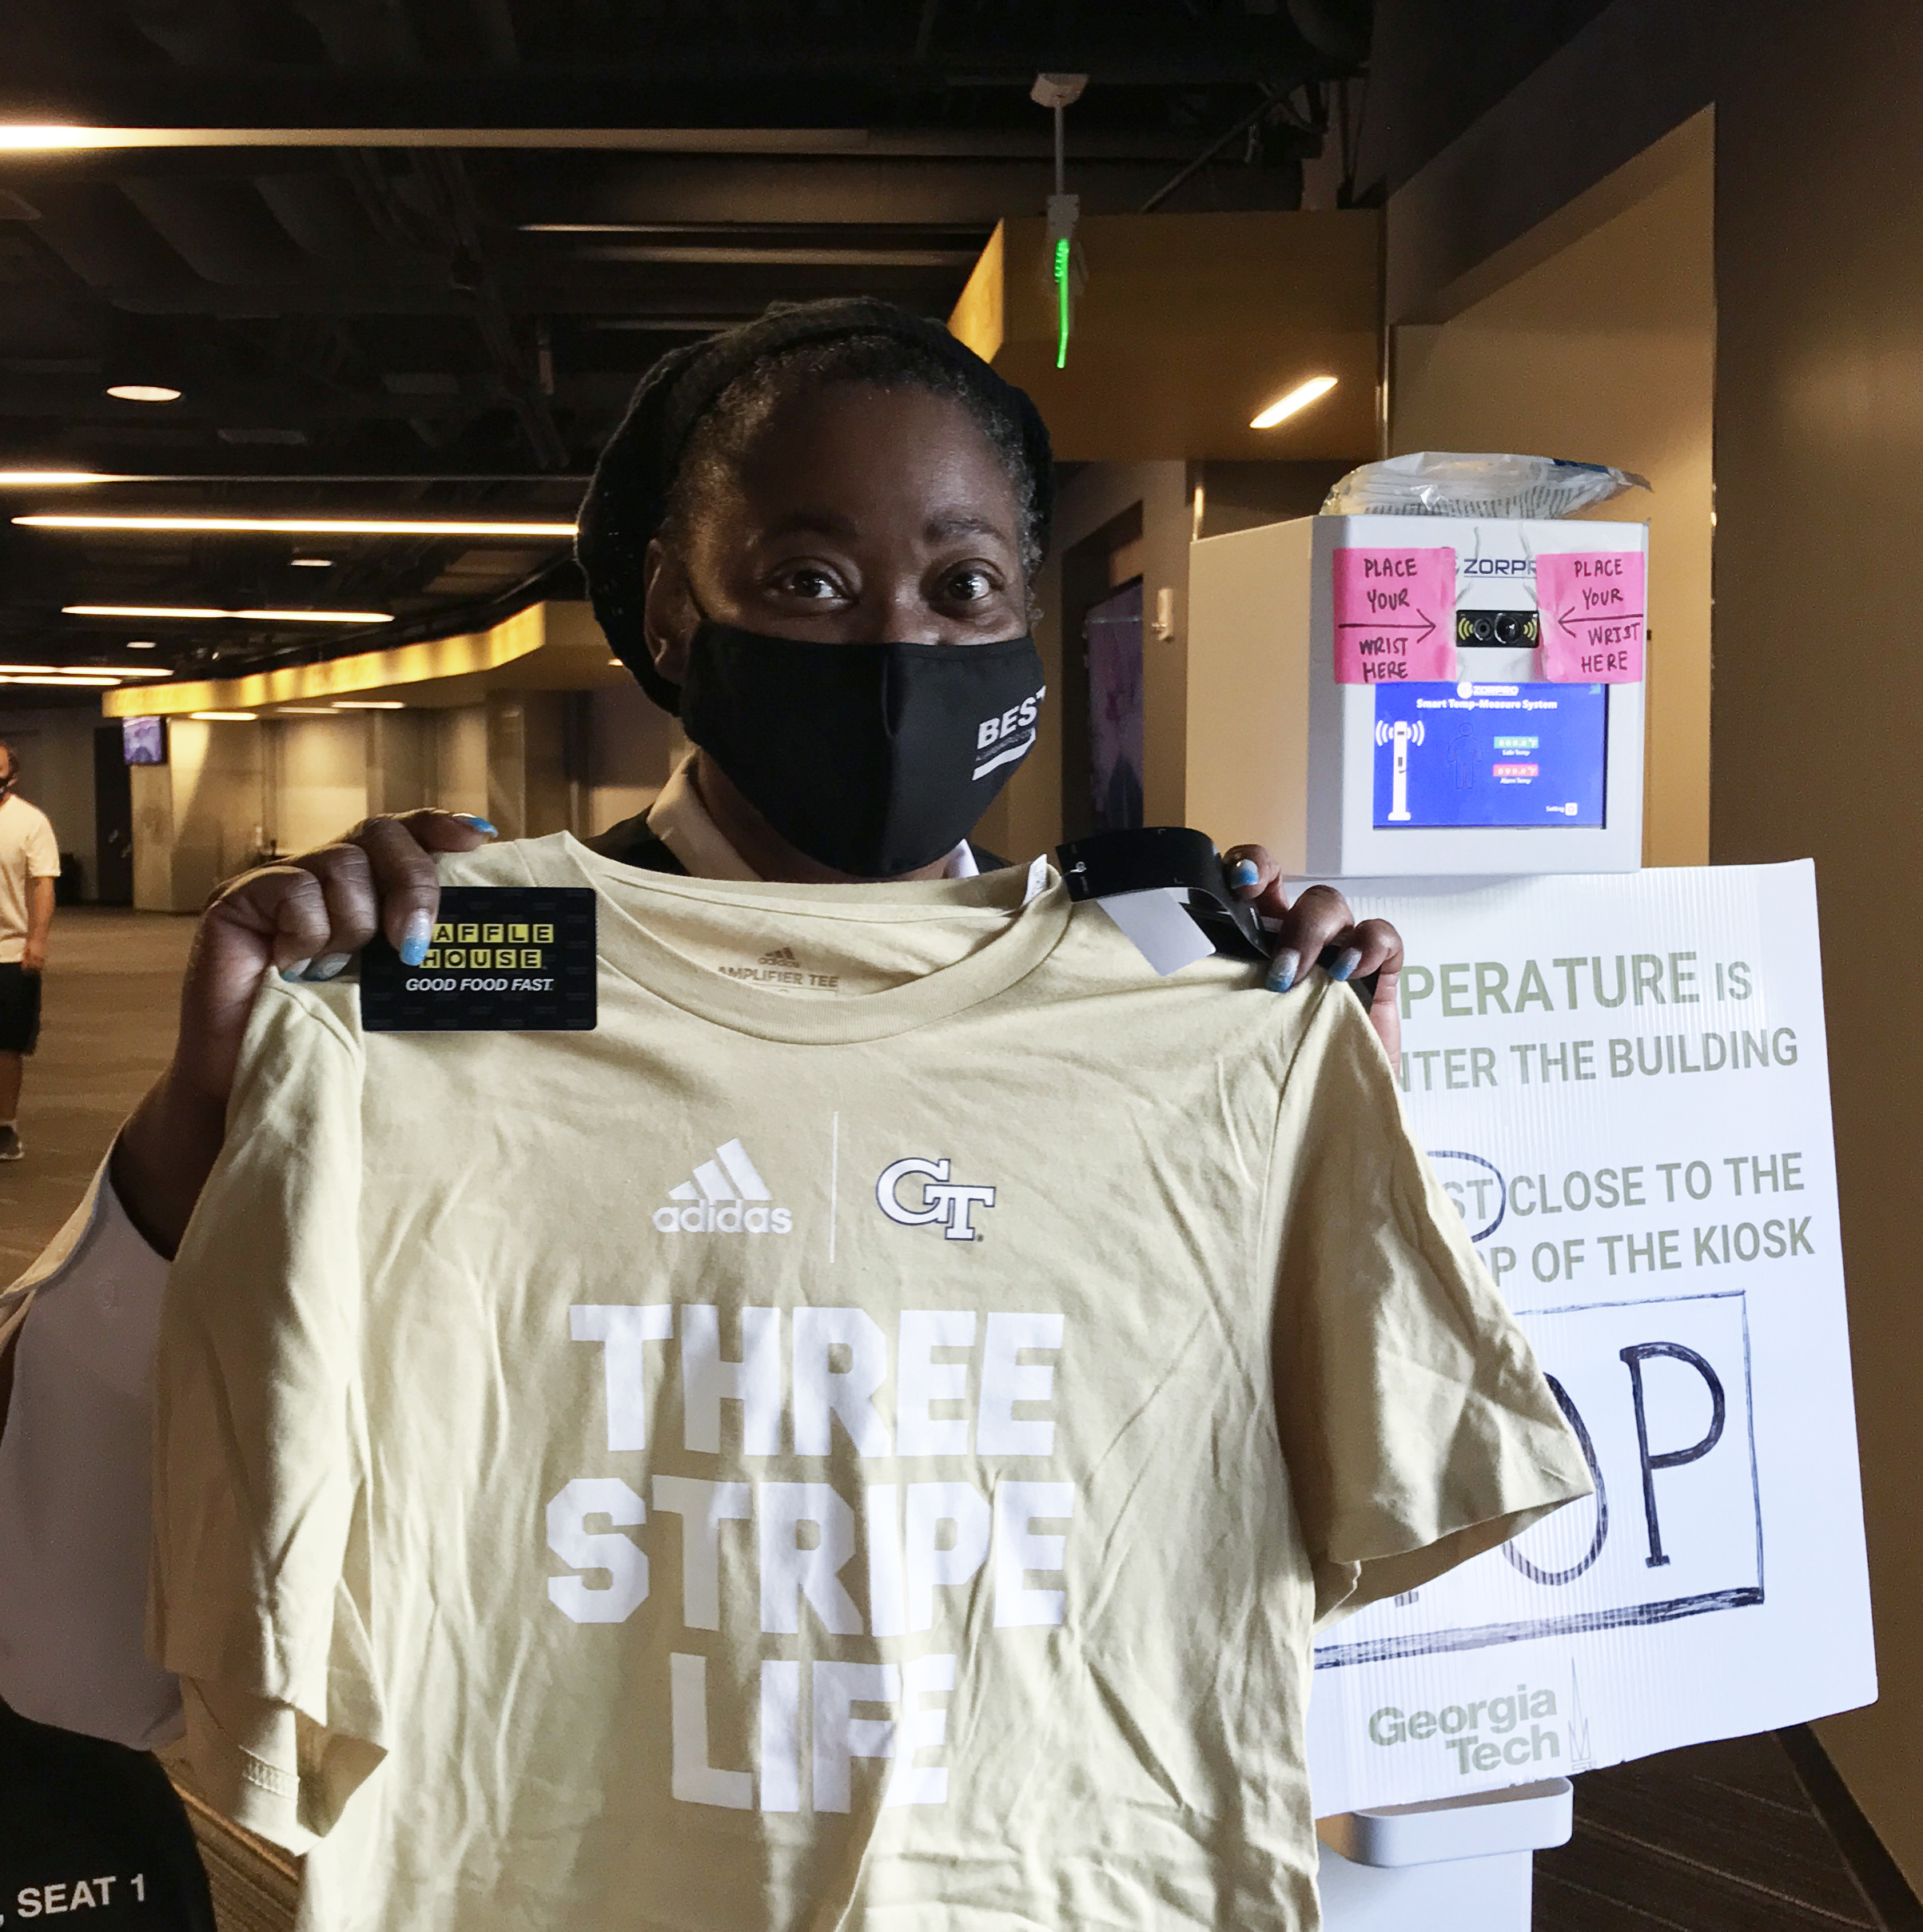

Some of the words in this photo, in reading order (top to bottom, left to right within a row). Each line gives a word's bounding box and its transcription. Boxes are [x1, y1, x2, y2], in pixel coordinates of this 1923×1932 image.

[1364, 557, 1418, 579] PLACE
[1463, 558, 1536, 576] ZORPR
[1575, 559, 1623, 578] PLACE
[1367, 588, 1410, 613] YOUR
[1583, 587, 1624, 611] YOUR
[1359, 636, 1409, 656] WRIST
[1588, 622, 1641, 646] WRIST
[1362, 660, 1408, 683] HERE
[1581, 651, 1628, 674] HERE
[1416, 698, 1447, 709] Smart
[1448, 698, 1522, 711] Temp-Measure
[1522, 699, 1558, 711] System
[435, 925, 551, 942] AFFLE
[424, 950, 539, 968] HOUSE
[405, 978, 457, 992] GOOD
[460, 978, 509, 992] FOOD
[808, 974, 839, 988] TEE
[1399, 950, 1700, 1020] PERATURE
[1716, 960, 1753, 1002] IS
[1509, 1040, 1597, 1085] THE
[1609, 1026, 1798, 1078] BUILDING
[1507, 1167, 1646, 1217] CLOSE
[1656, 1159, 1712, 1203] TO
[1723, 1152, 1806, 1195] THE
[652, 1200, 793, 1235] adidas
[1531, 1238, 1586, 1284] OF
[1597, 1229, 1682, 1277] THE
[1694, 1215, 1815, 1266] KIOSK
[568, 1303, 1065, 1459] THREE
[545, 1474, 1075, 1639] STRIPE
[1368, 1683, 1558, 1747] Georgia
[669, 1651, 957, 1814] LIFE
[1444, 1723, 1560, 1775] Tech
[17, 1875, 117, 1918] SEAT
[130, 1873, 146, 1902] 1
